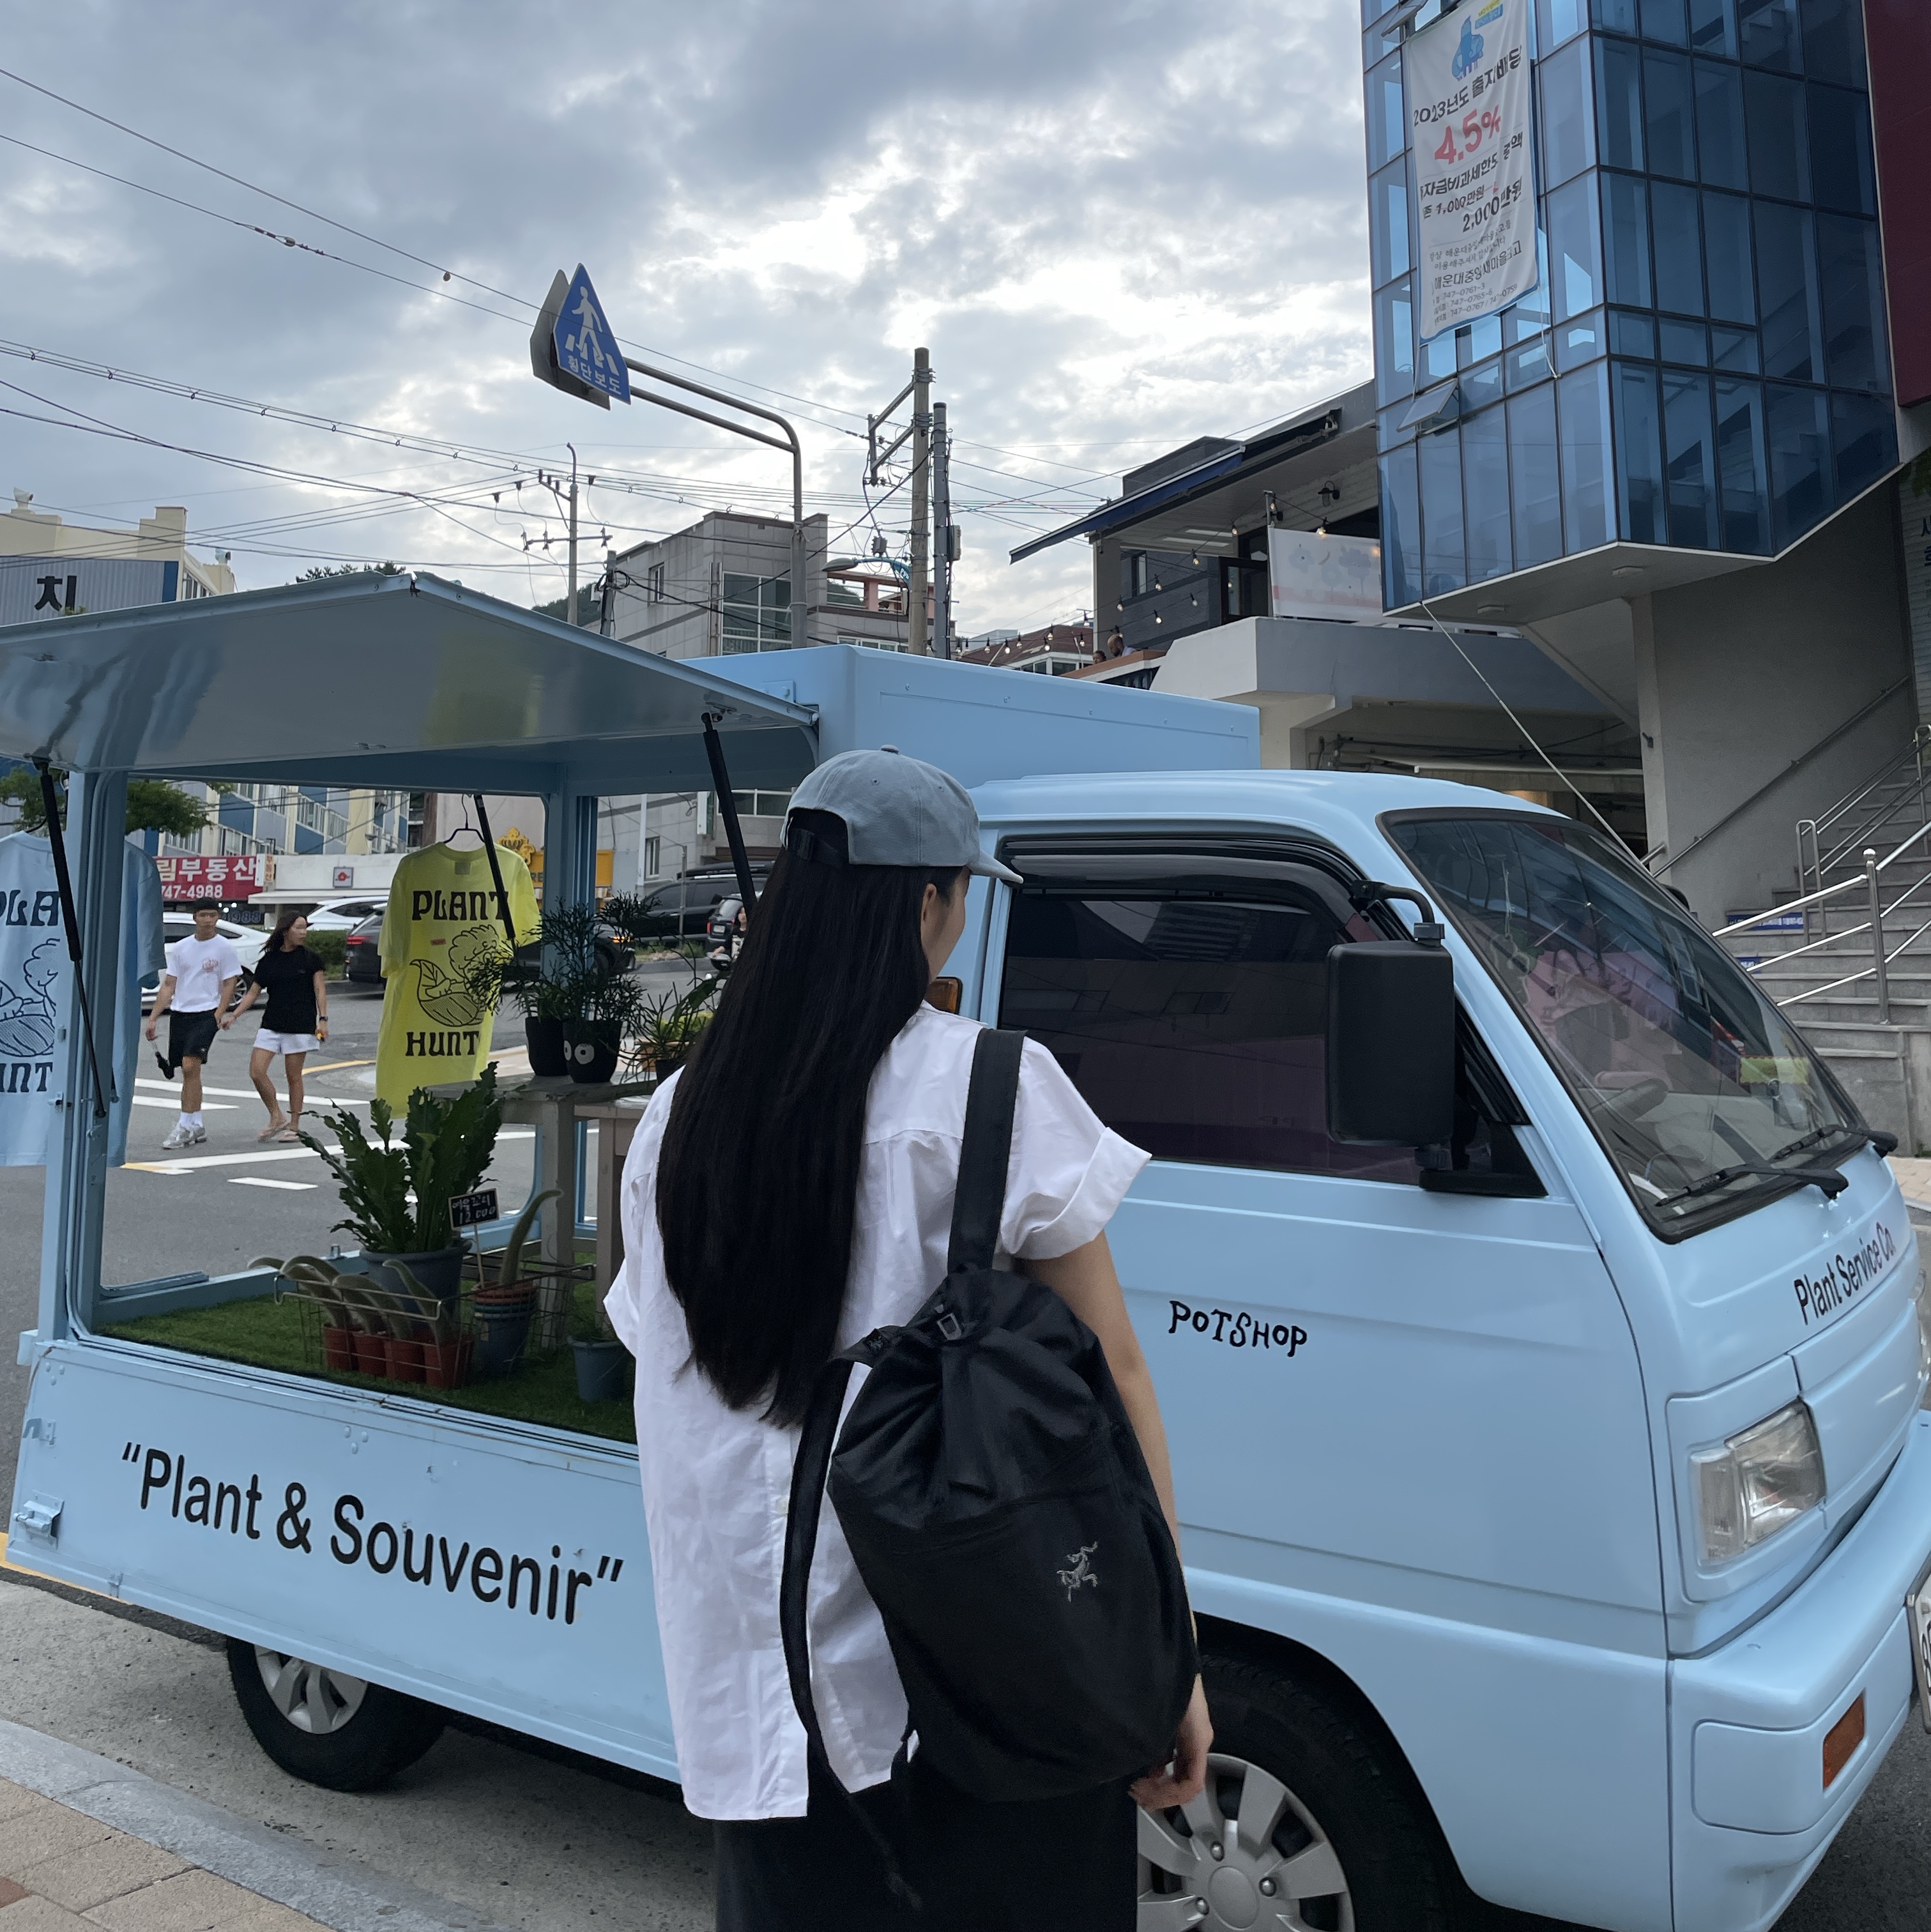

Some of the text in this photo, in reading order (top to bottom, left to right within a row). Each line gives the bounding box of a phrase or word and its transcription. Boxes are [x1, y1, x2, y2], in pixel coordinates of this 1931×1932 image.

[1414, 86, 1469, 127] 2023년도
[1434, 104, 1501, 165] 4.5%
[1435, 185, 1485, 215] 1,000만원
[1462, 176, 1523, 232] 2,000만원
[568, 355, 622, 395] 횡단보도
[34, 575, 77, 611] 치
[162, 884, 223, 899] 747-4988
[1794, 1221, 1897, 1325] Plant Service Co.
[276, 1482, 312, 1554] &
